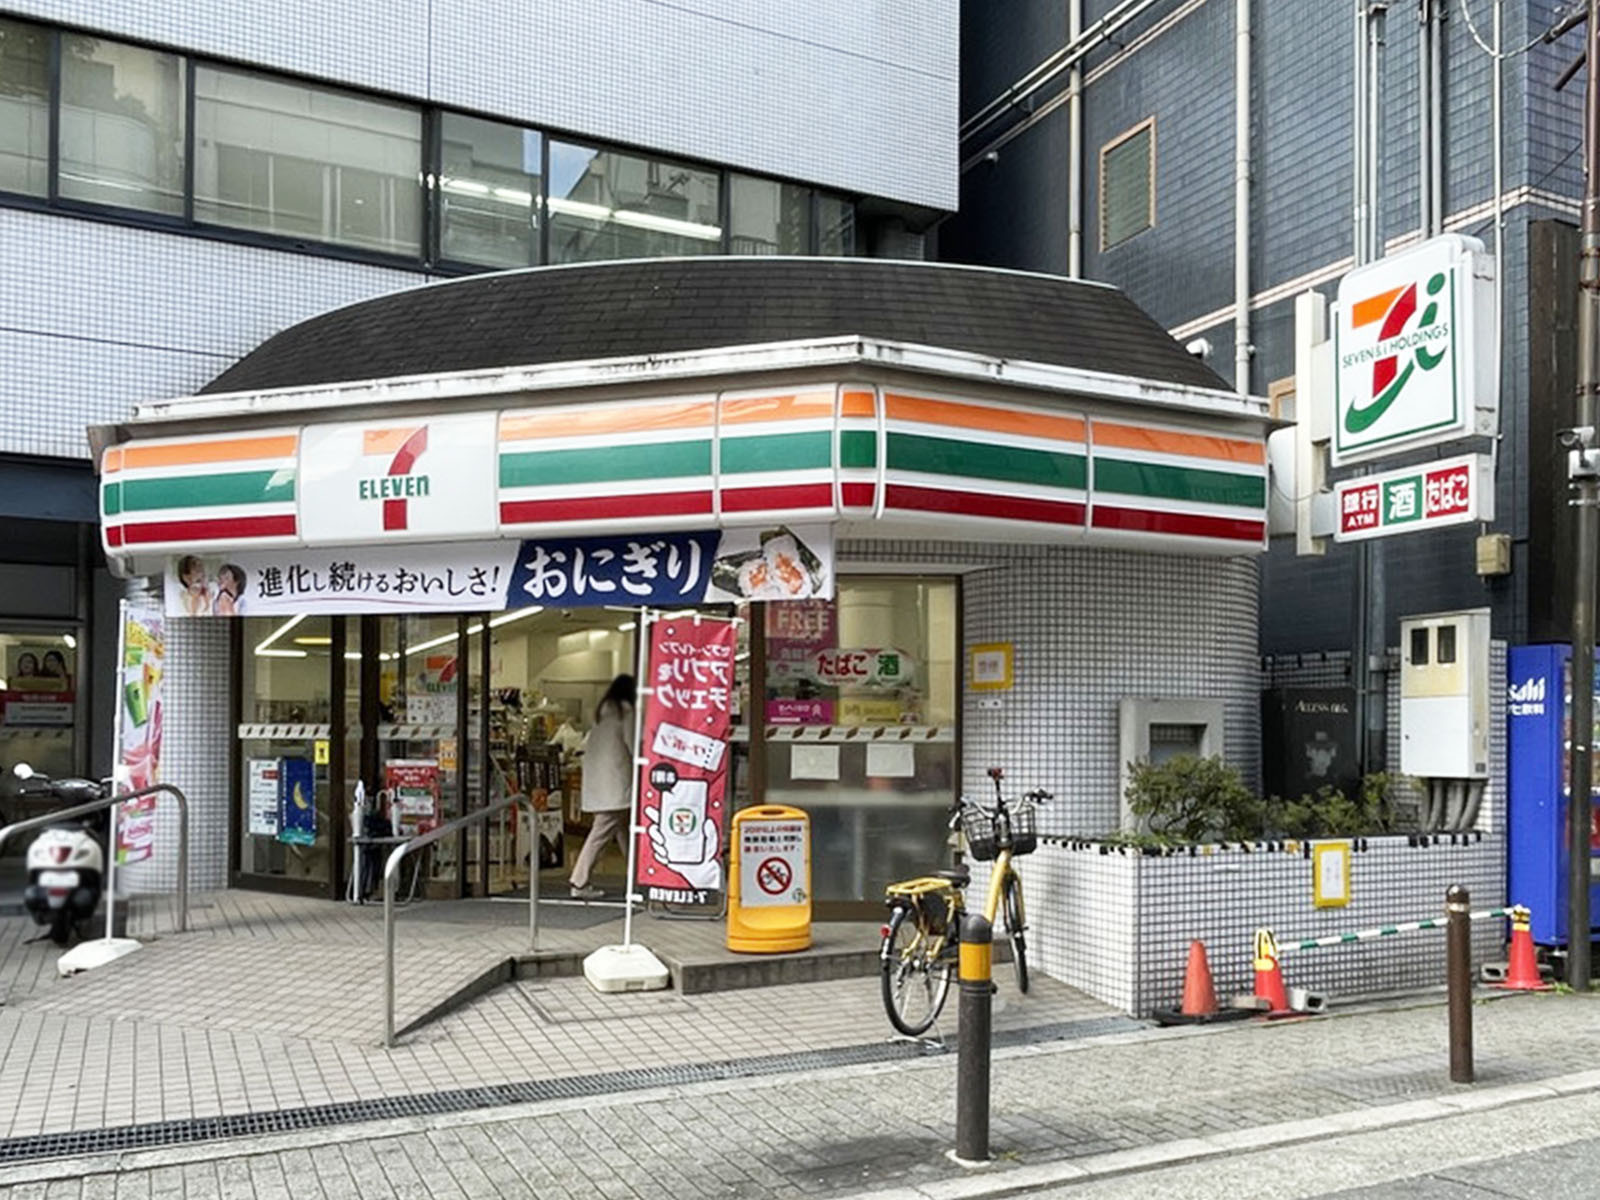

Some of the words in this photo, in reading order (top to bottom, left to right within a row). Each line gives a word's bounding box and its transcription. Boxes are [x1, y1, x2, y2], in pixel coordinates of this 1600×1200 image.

[1389, 322, 1449, 353] HOLDINGS
[1344, 489, 1378, 514] 銀行
[1389, 482, 1416, 520] 酒
[1427, 474, 1468, 512] たばこ
[1348, 513, 1375, 527] ATM
[523, 540, 700, 598] おにぎり
[817, 653, 868, 676] たばこ
[877, 654, 900, 676] 酒
